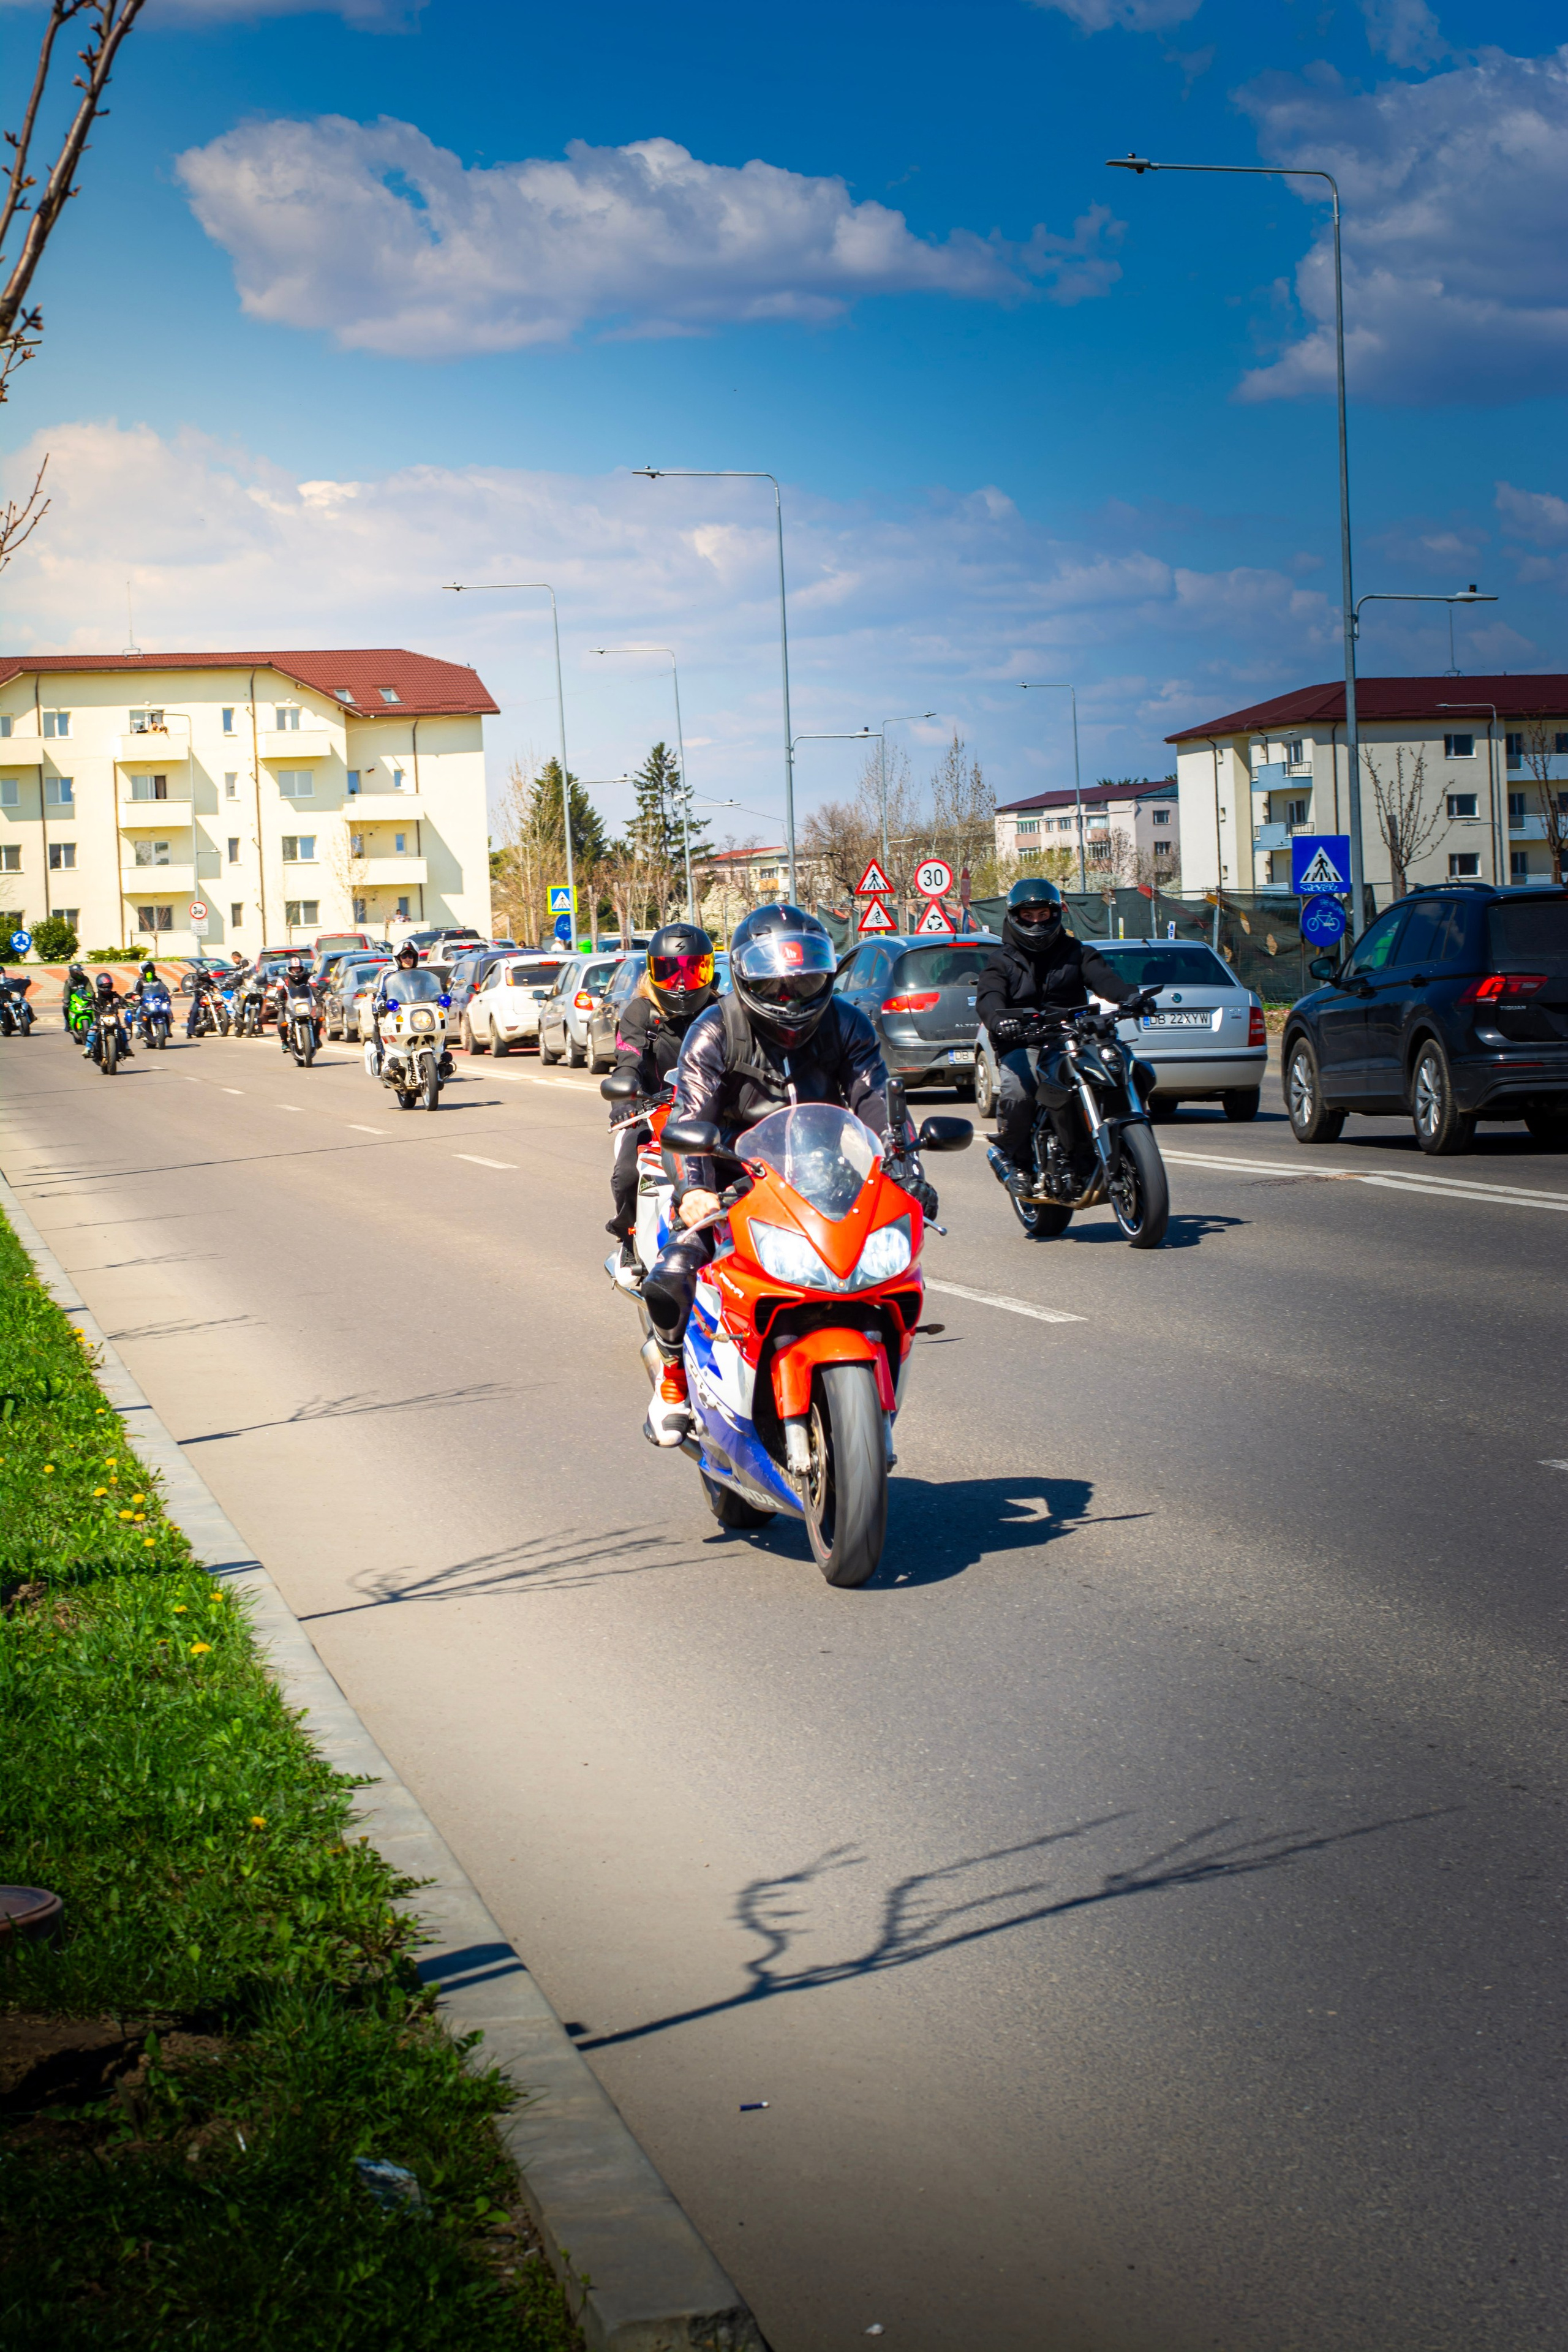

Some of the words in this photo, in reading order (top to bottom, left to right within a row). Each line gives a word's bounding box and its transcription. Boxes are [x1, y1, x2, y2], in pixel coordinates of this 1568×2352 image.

[924, 869, 943, 887] 30
[1150, 1014, 1166, 1025] DB
[1170, 1013, 1208, 1024] 22XYW
[955, 1050, 968, 1060] DB
